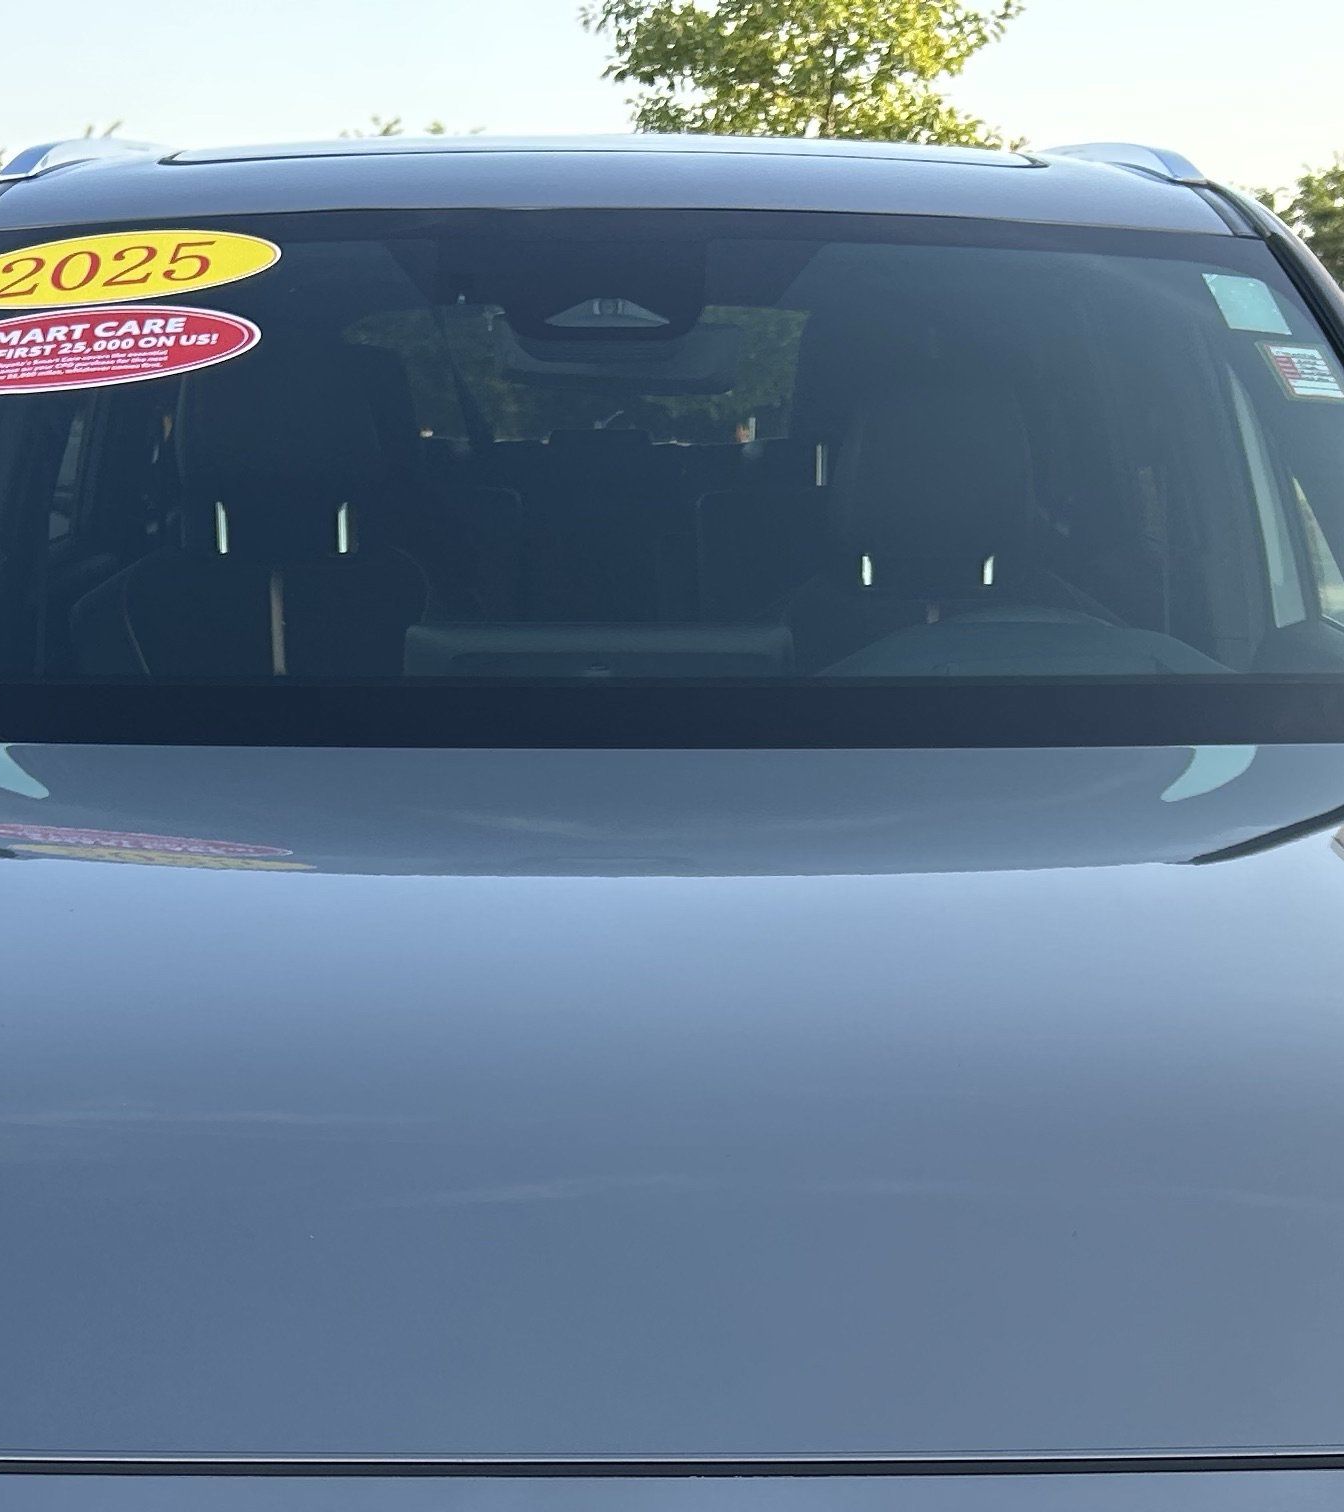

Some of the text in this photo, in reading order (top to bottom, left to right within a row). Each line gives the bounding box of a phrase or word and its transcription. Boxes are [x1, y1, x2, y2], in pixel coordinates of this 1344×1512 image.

[94, 317, 187, 337] CARE
[58, 338, 135, 354] 25,000
[138, 336, 176, 348] ON
[179, 333, 219, 346] US!
